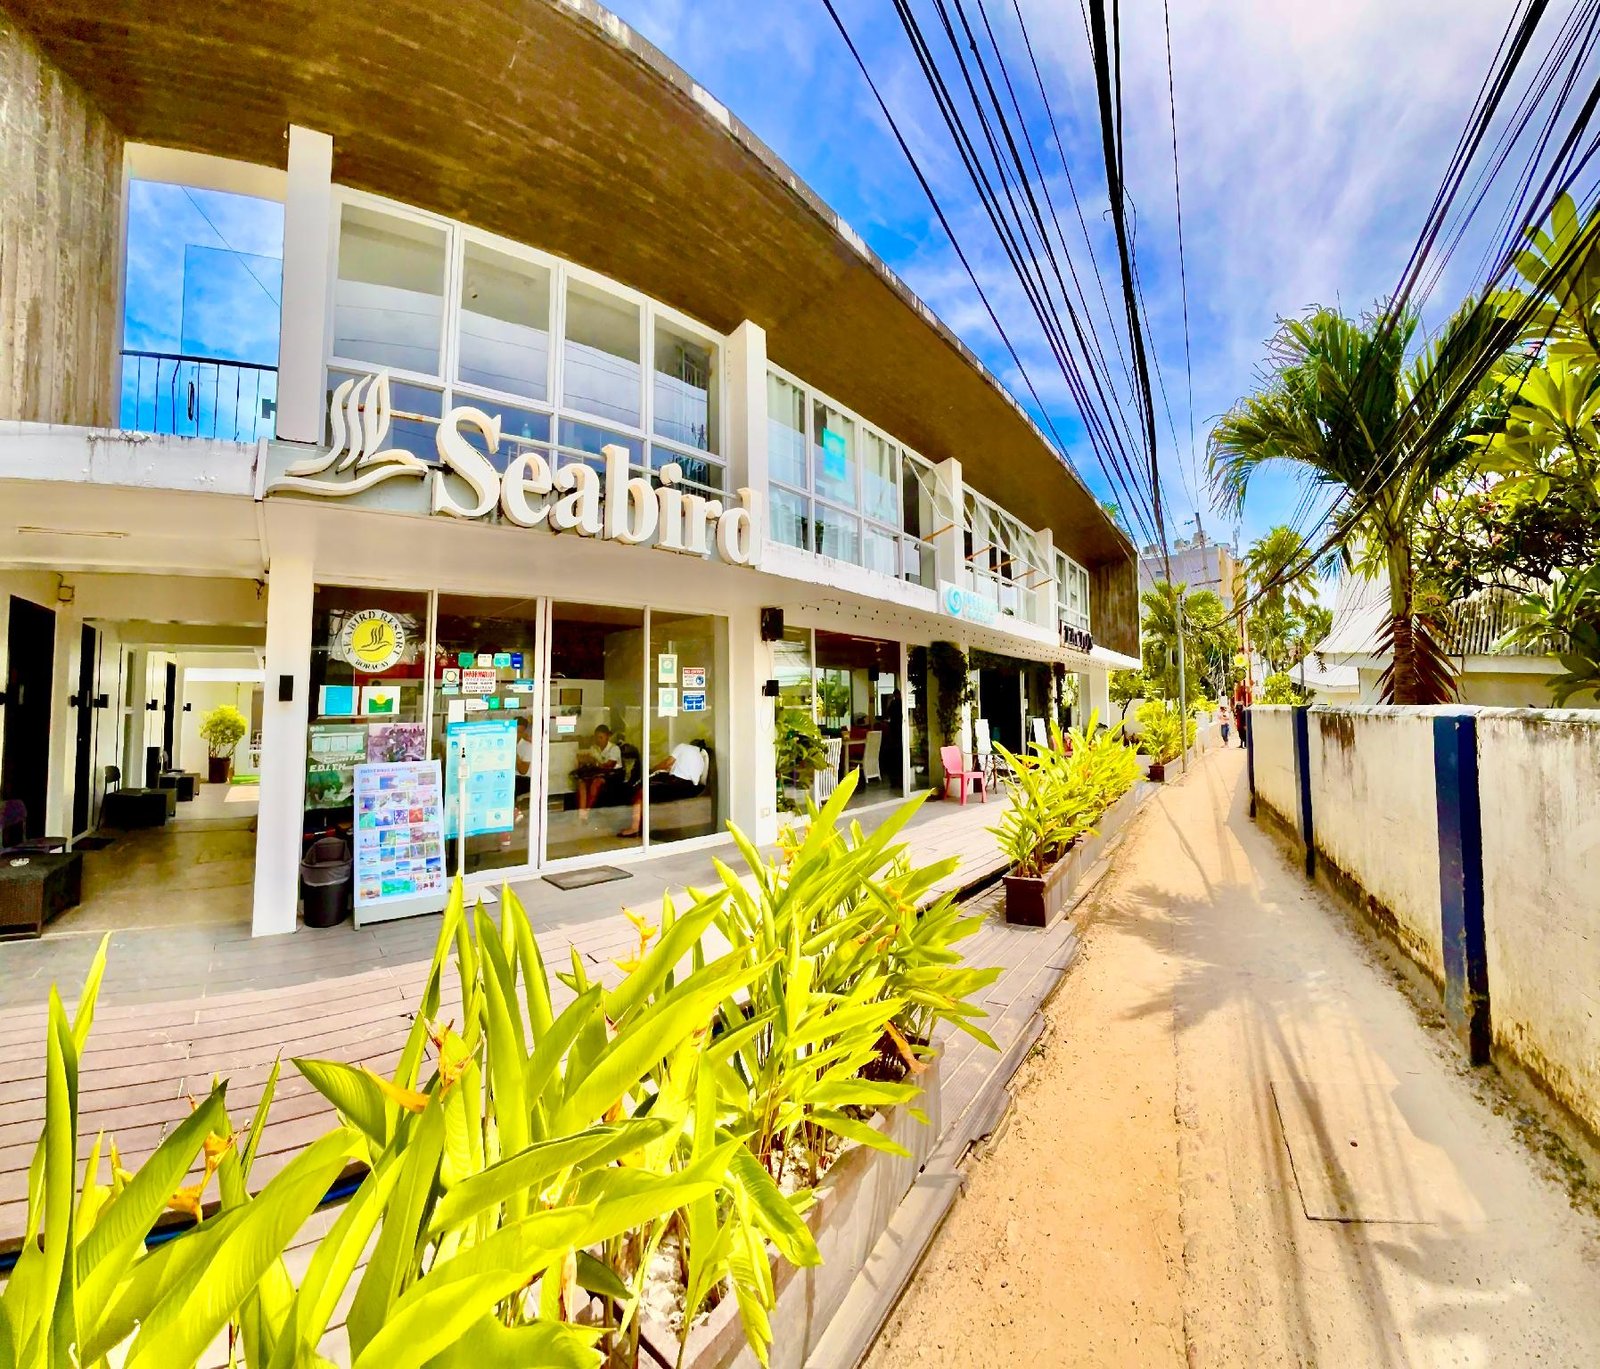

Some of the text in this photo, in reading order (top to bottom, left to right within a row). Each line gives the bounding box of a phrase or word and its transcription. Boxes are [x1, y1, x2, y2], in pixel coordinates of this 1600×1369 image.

[432, 405, 763, 567] Seabird
[343, 610, 404, 655] SEABIRD RESORT
[355, 658, 389, 669] BORACAY
